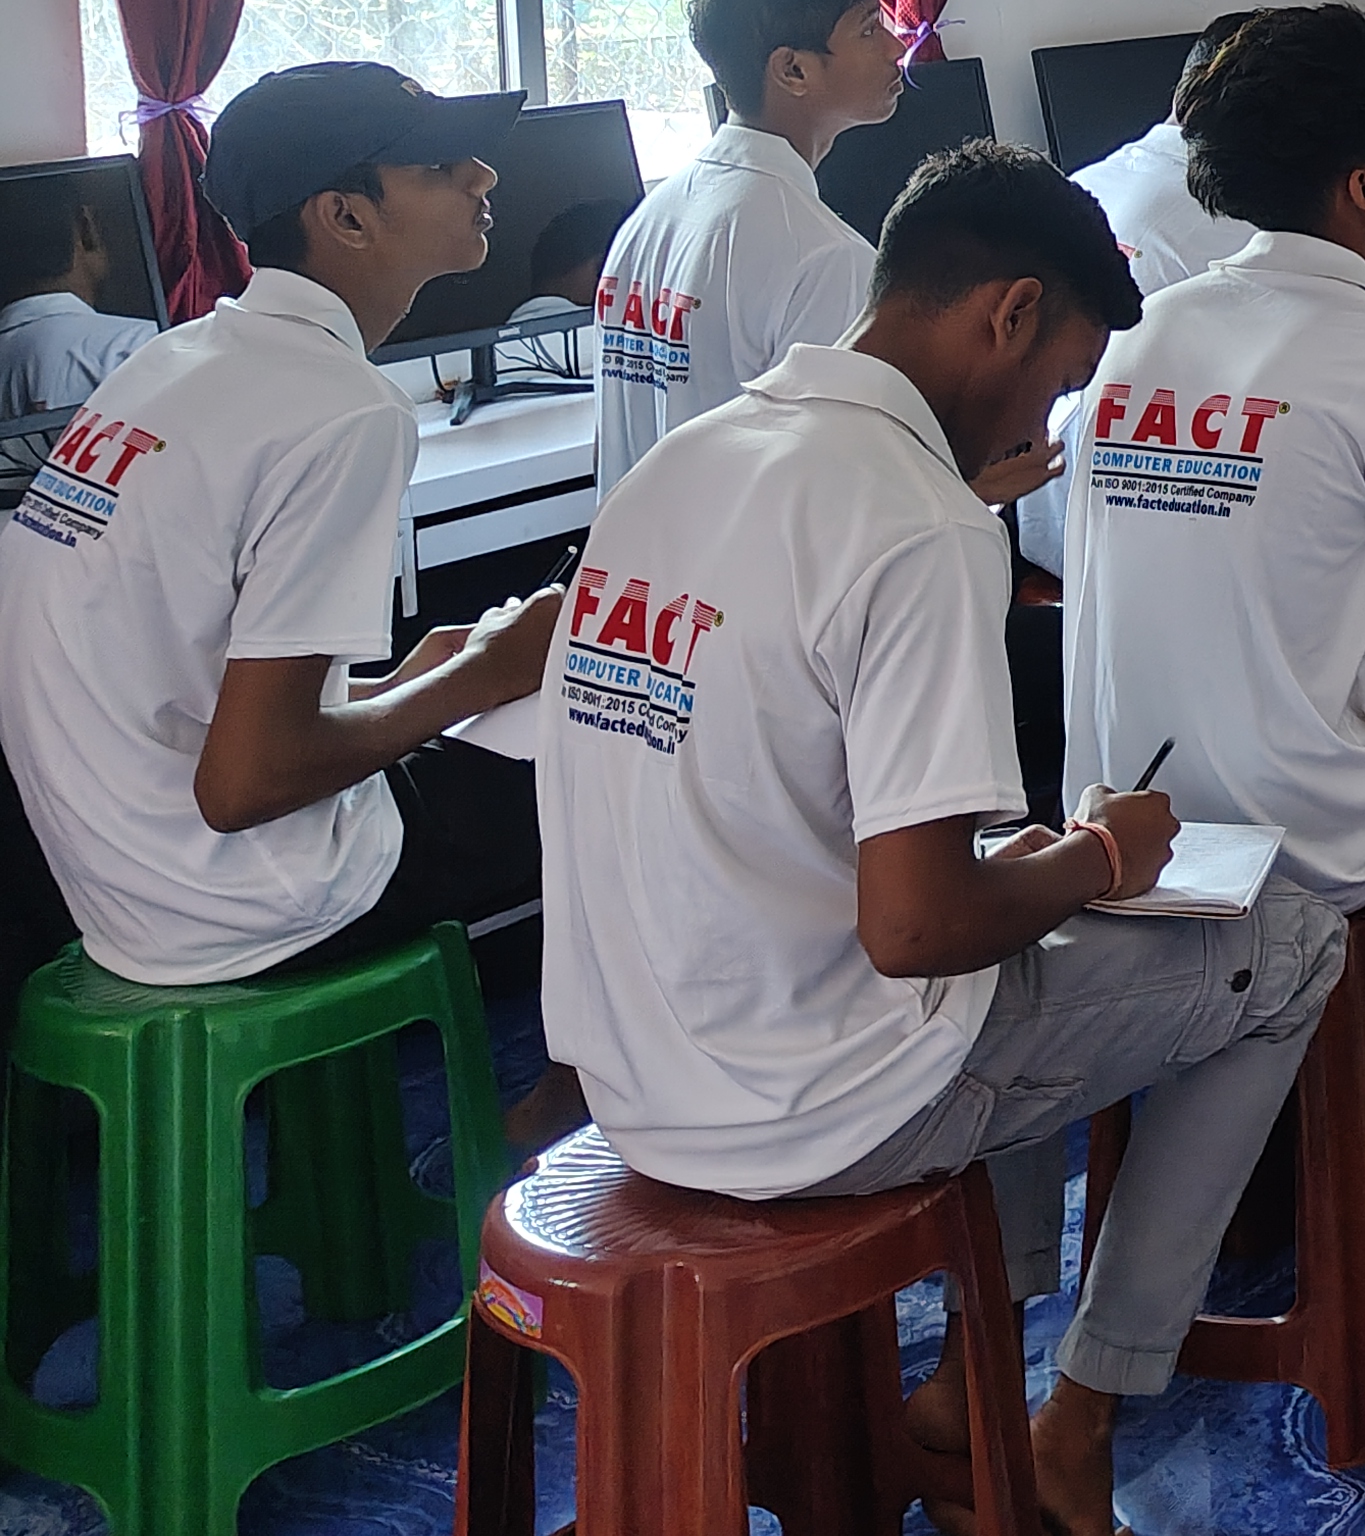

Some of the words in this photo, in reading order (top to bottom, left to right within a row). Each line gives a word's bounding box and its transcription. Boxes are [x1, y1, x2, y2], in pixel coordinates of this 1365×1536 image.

[597, 276, 694, 342] FACT
[1094, 383, 1280, 454] FACT
[54, 407, 160, 487] ACT
[1092, 450, 1173, 474] COMPUTER
[1176, 459, 1262, 483] EDUCATION
[1091, 476, 1103, 489] An
[1104, 478, 1120, 490] ISO
[1121, 479, 1169, 495] 9001:2015
[1170, 484, 1205, 498] Certified
[1206, 486, 1256, 506] Company
[1105, 493, 1231, 519] www.facteducation.in
[570, 566, 717, 676] FACT
[566, 652, 642, 688] OMPUTER
